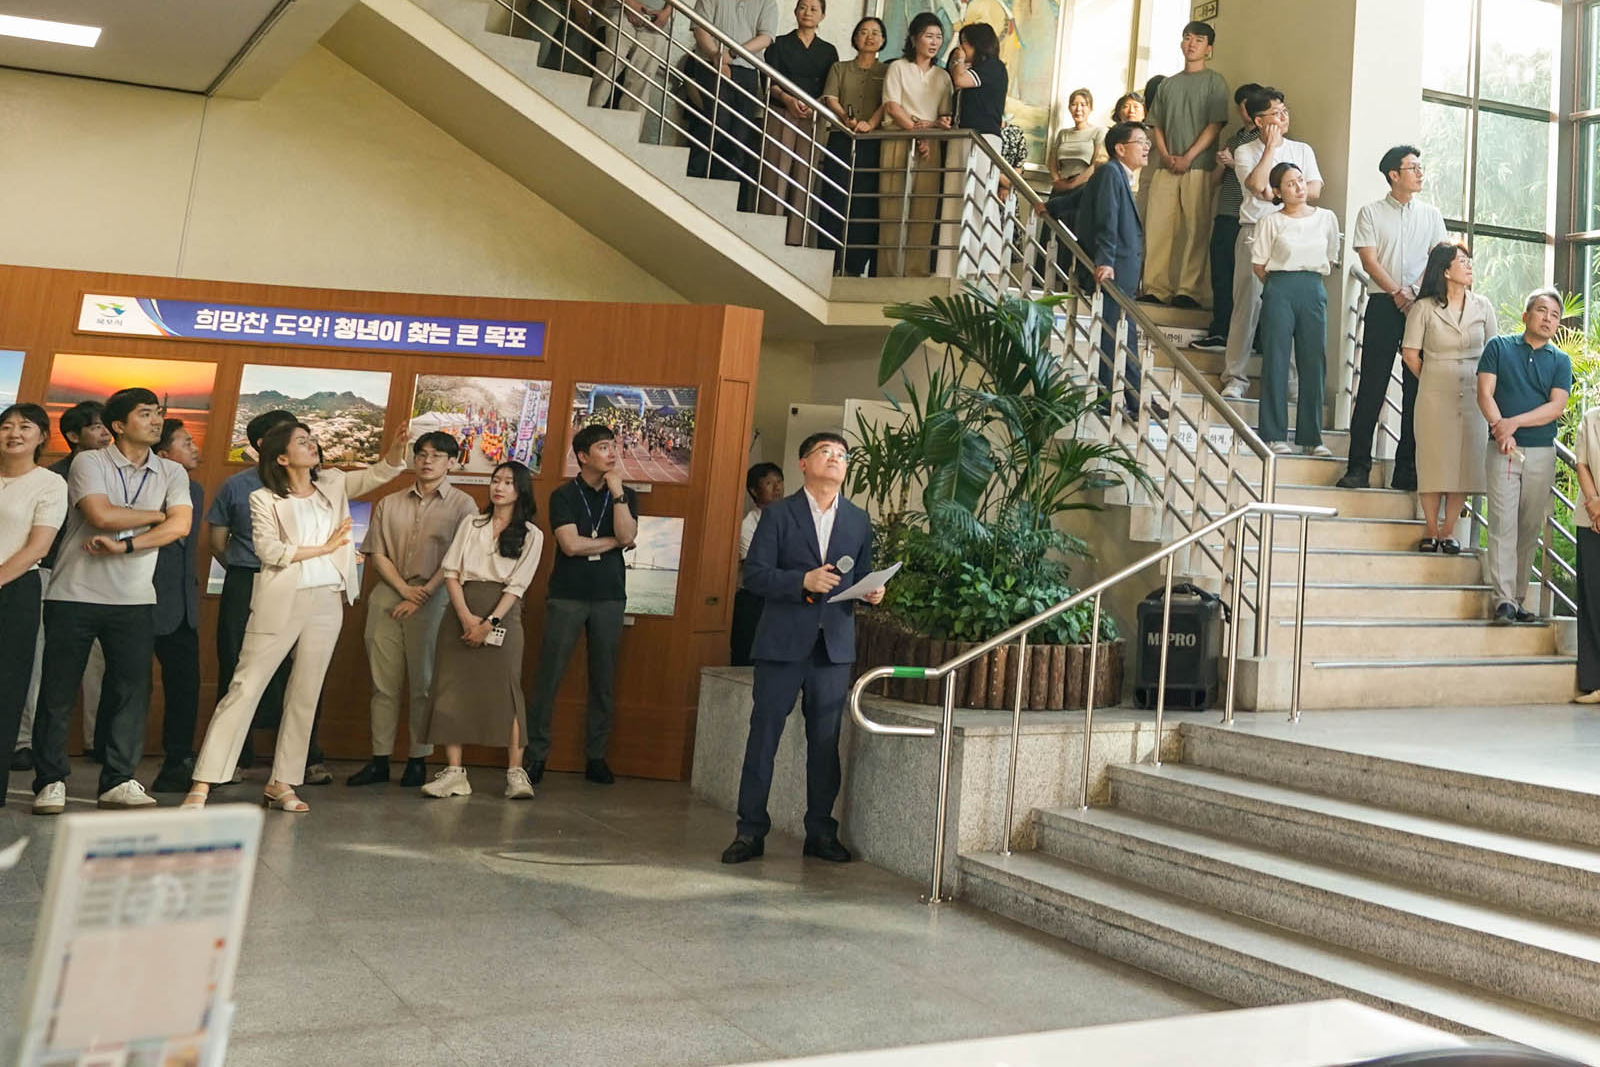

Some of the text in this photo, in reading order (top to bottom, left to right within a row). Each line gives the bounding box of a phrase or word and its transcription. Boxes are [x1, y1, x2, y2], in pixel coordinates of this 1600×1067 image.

[193, 308, 528, 349] 희망찬 도약! 청년이 찾는 큰 목포
[1147, 632, 1196, 647] MPRO
